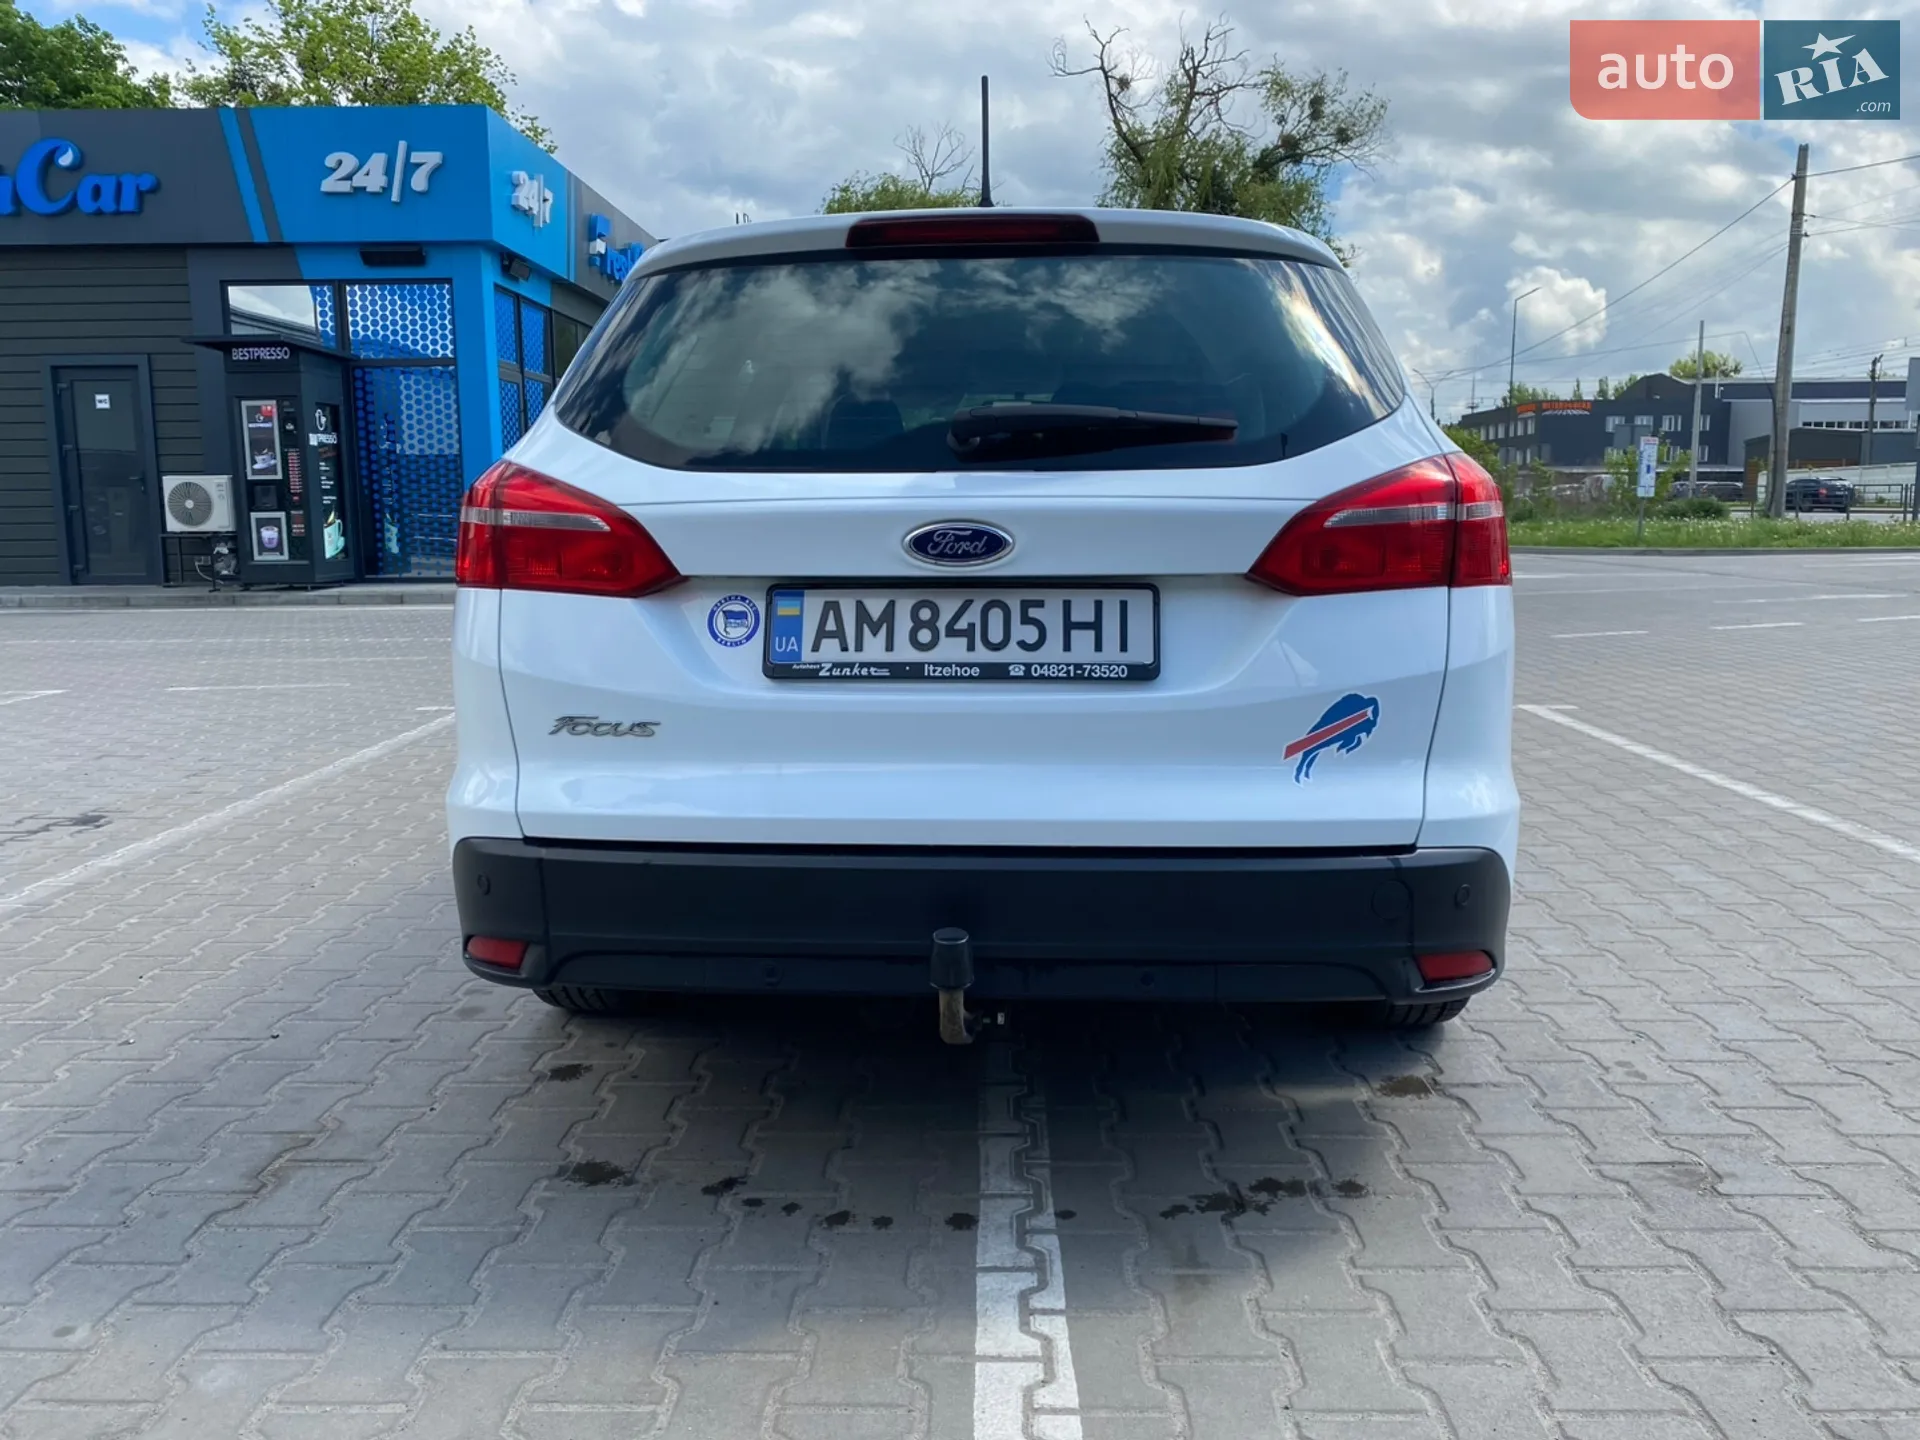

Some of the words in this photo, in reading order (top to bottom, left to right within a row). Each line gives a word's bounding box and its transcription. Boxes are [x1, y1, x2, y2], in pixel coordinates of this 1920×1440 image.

[320, 140, 443, 203] 24/7
[231, 347, 290, 360] BESTPRESSO
[926, 529, 988, 555] Ford
[775, 636, 799, 653] UA
[923, 663, 981, 677] Itzehoe
[1031, 663, 1128, 678] 04821-73520
